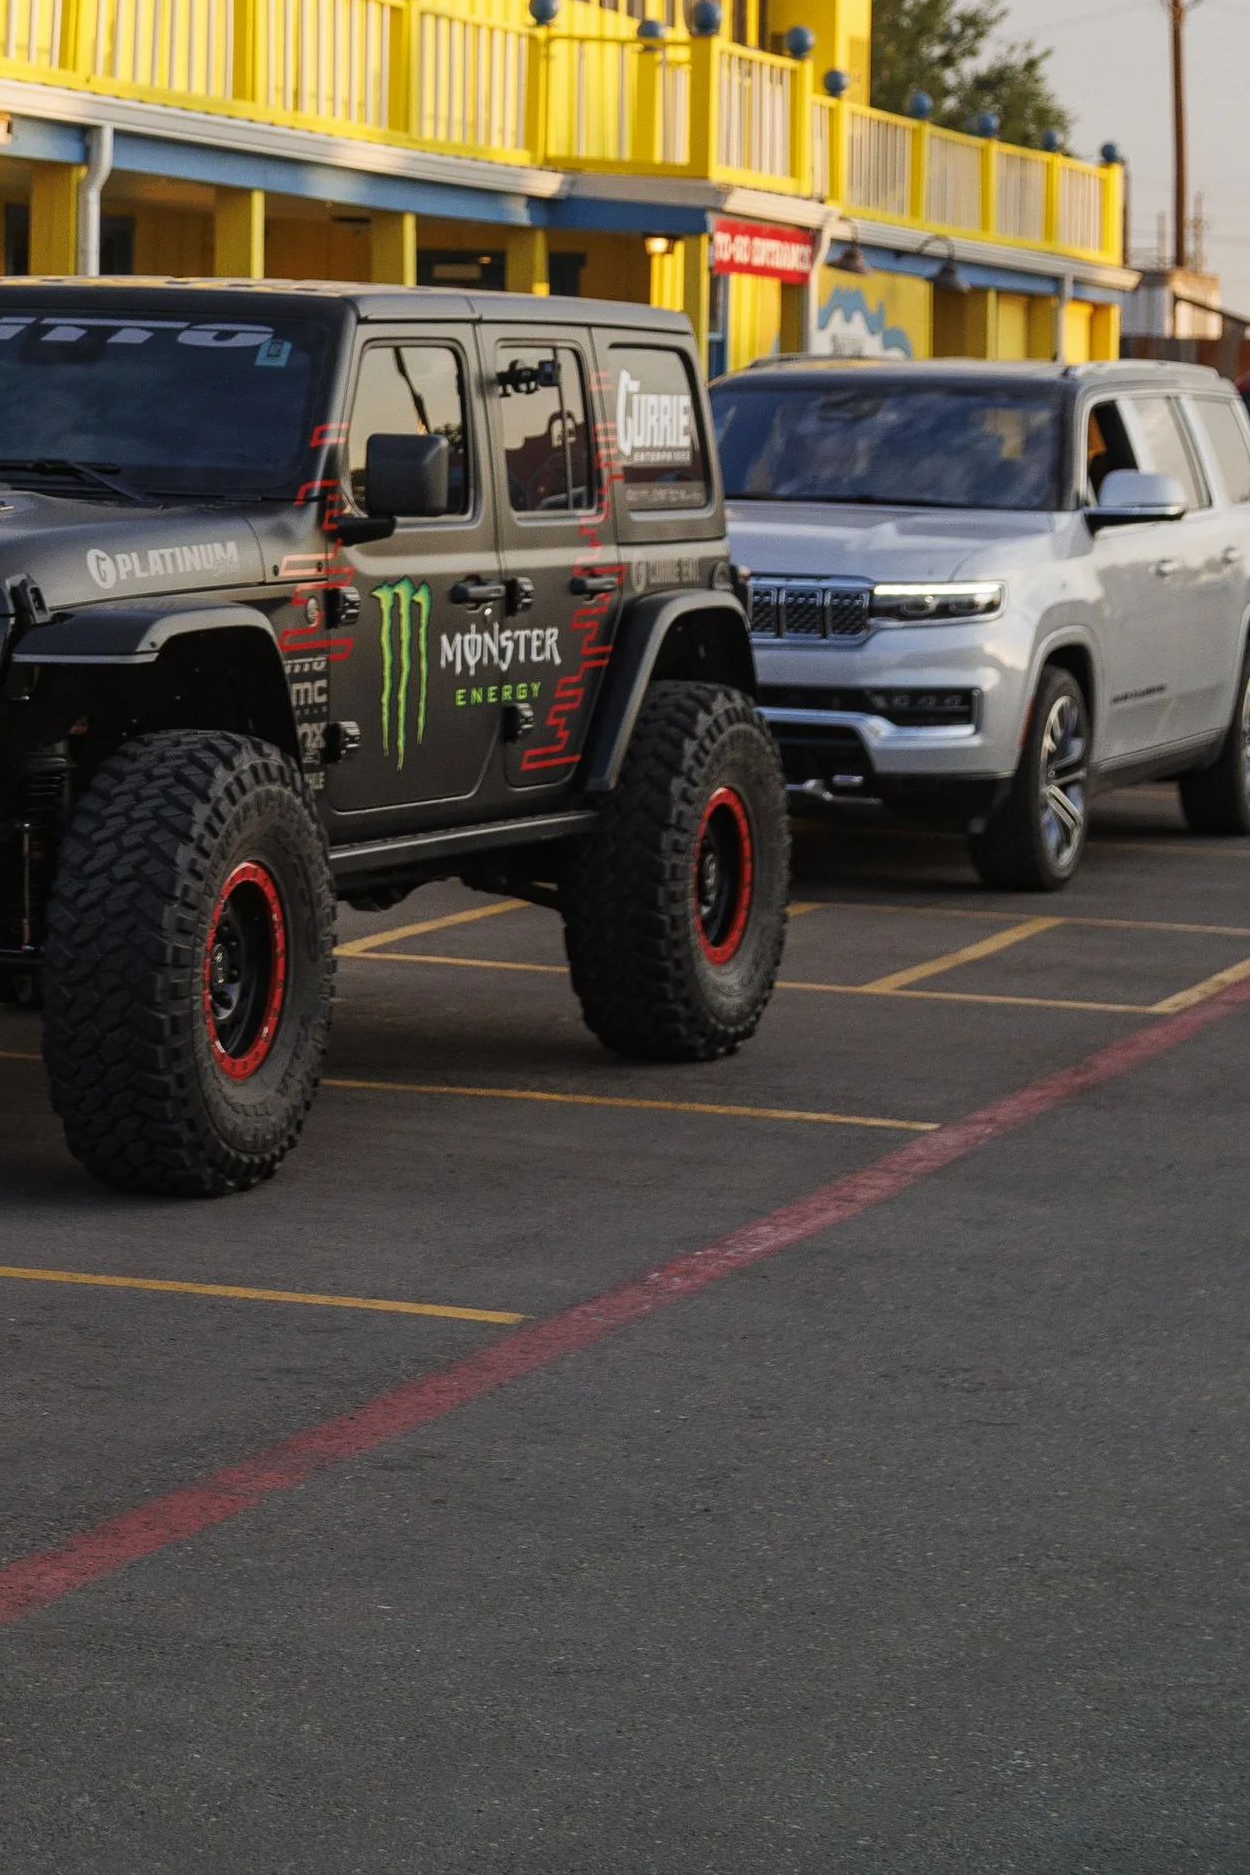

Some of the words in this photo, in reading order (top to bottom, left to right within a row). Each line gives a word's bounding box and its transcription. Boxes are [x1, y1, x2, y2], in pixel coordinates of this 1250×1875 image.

[616, 368, 691, 457] CURRIE
[115, 540, 239, 580] PLATINUM
[439, 621, 562, 676] MONSTER
[455, 681, 541, 706] ENERGY
